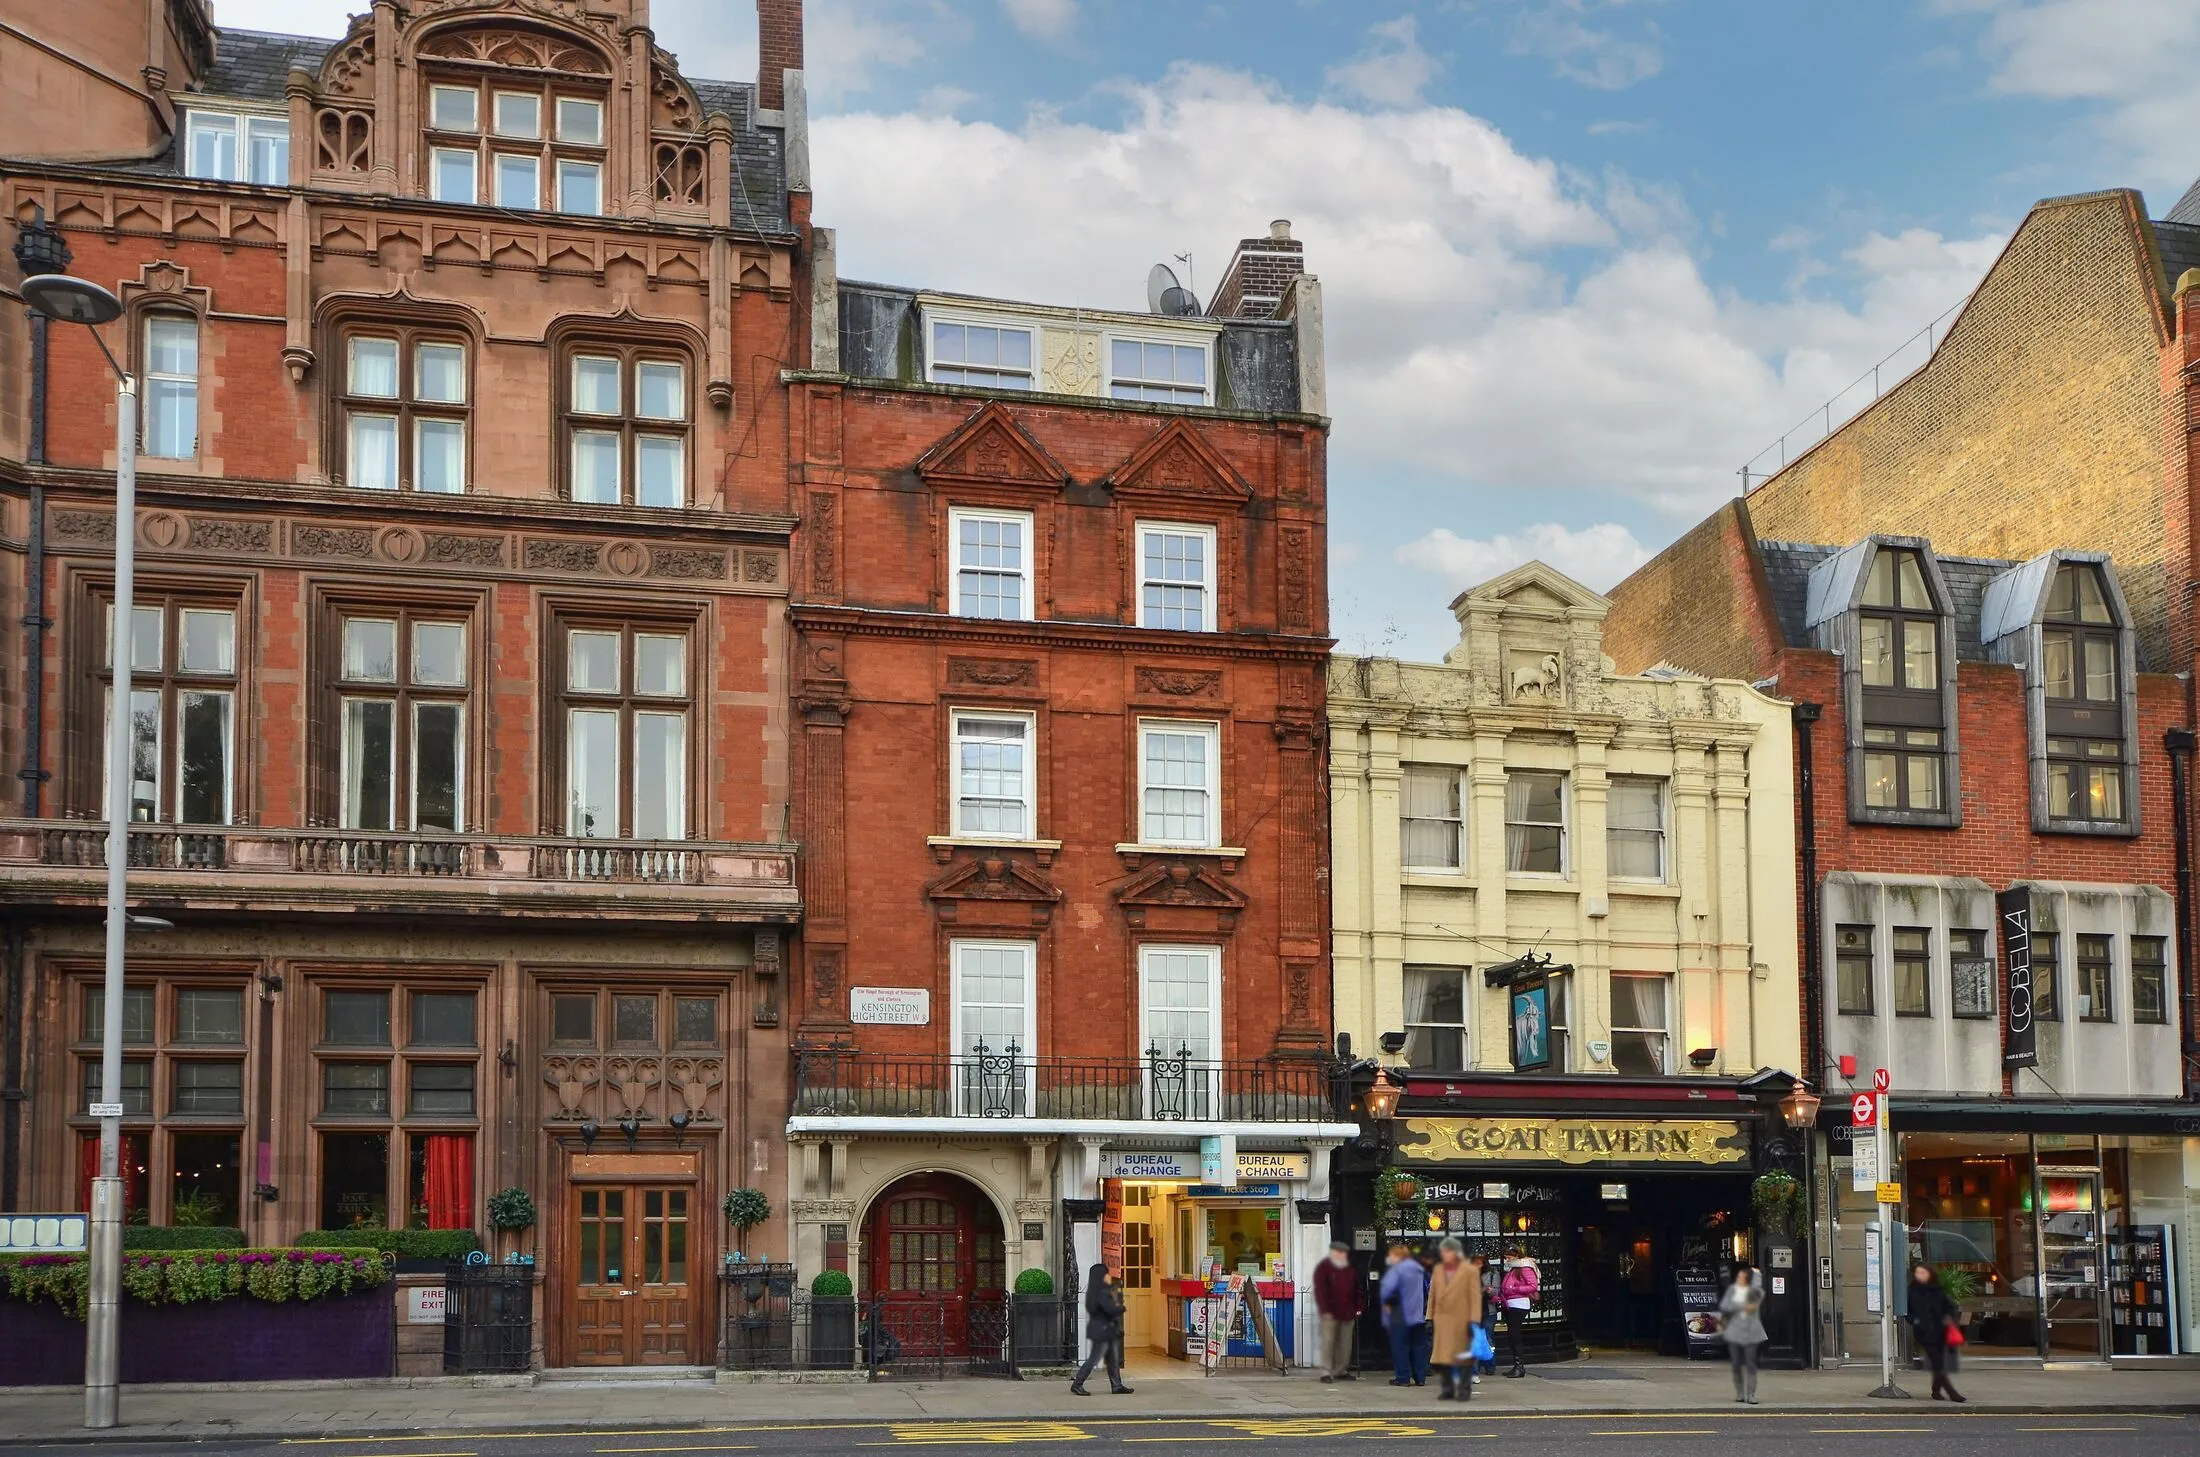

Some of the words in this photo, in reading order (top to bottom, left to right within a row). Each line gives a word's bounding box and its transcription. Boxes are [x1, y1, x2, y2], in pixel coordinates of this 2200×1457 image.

[2005, 910, 2031, 1033] COBELLA
[862, 1003, 919, 1012] KENSINGTON
[853, 1012, 876, 1021] HIGH
[1875, 1071, 1886, 1087] N
[1456, 1127, 1544, 1151] GOAT
[1559, 1128, 1692, 1153] TAVERN
[1124, 1155, 1173, 1164] BUREAU
[1239, 1156, 1285, 1166] BUREAU
[1115, 1166, 1129, 1175] de
[1132, 1166, 1182, 1175] CHANGE
[1246, 1168, 1294, 1177] CHANGE
[1224, 1185, 1247, 1194] Ticket
[1250, 1186, 1269, 1196] Stop
[1425, 1183, 1457, 1199] FISH
